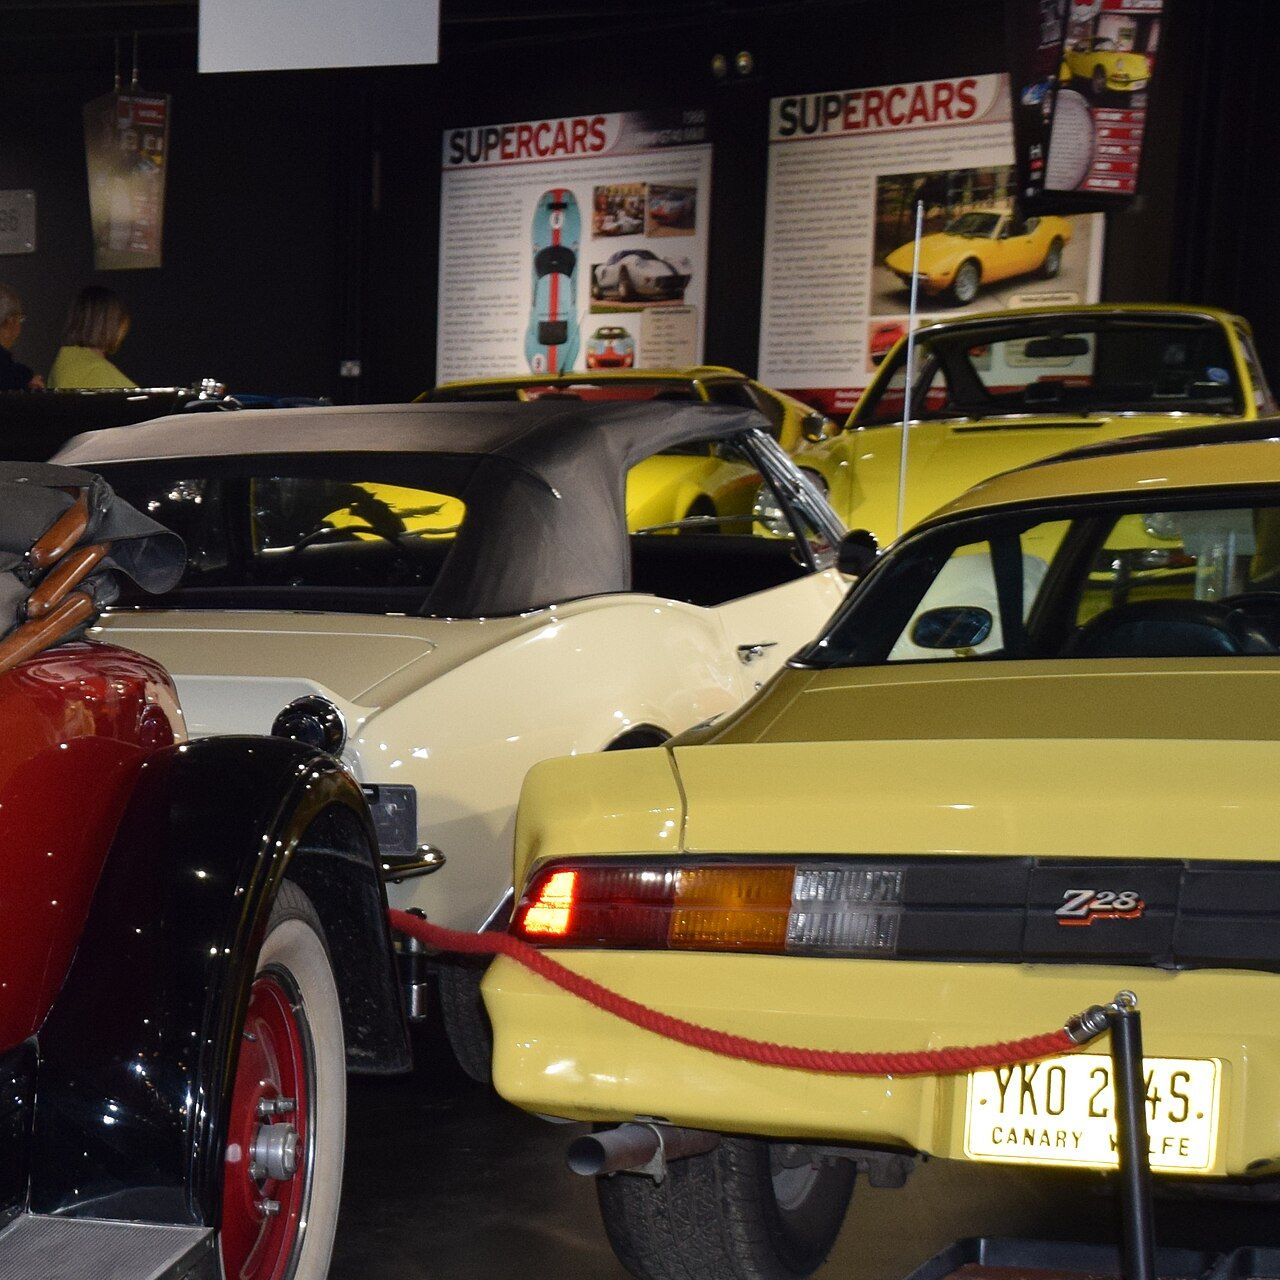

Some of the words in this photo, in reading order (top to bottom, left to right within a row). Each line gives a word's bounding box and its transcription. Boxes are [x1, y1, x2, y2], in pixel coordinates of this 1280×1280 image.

[779, 79, 977, 136] SUPERCARS
[449, 115, 607, 164] SUPERCARS
[1055, 889, 1140, 917] Z28
[1088, 1067, 1190, 1123] 24S
[992, 1127, 1083, 1149] CANARY
